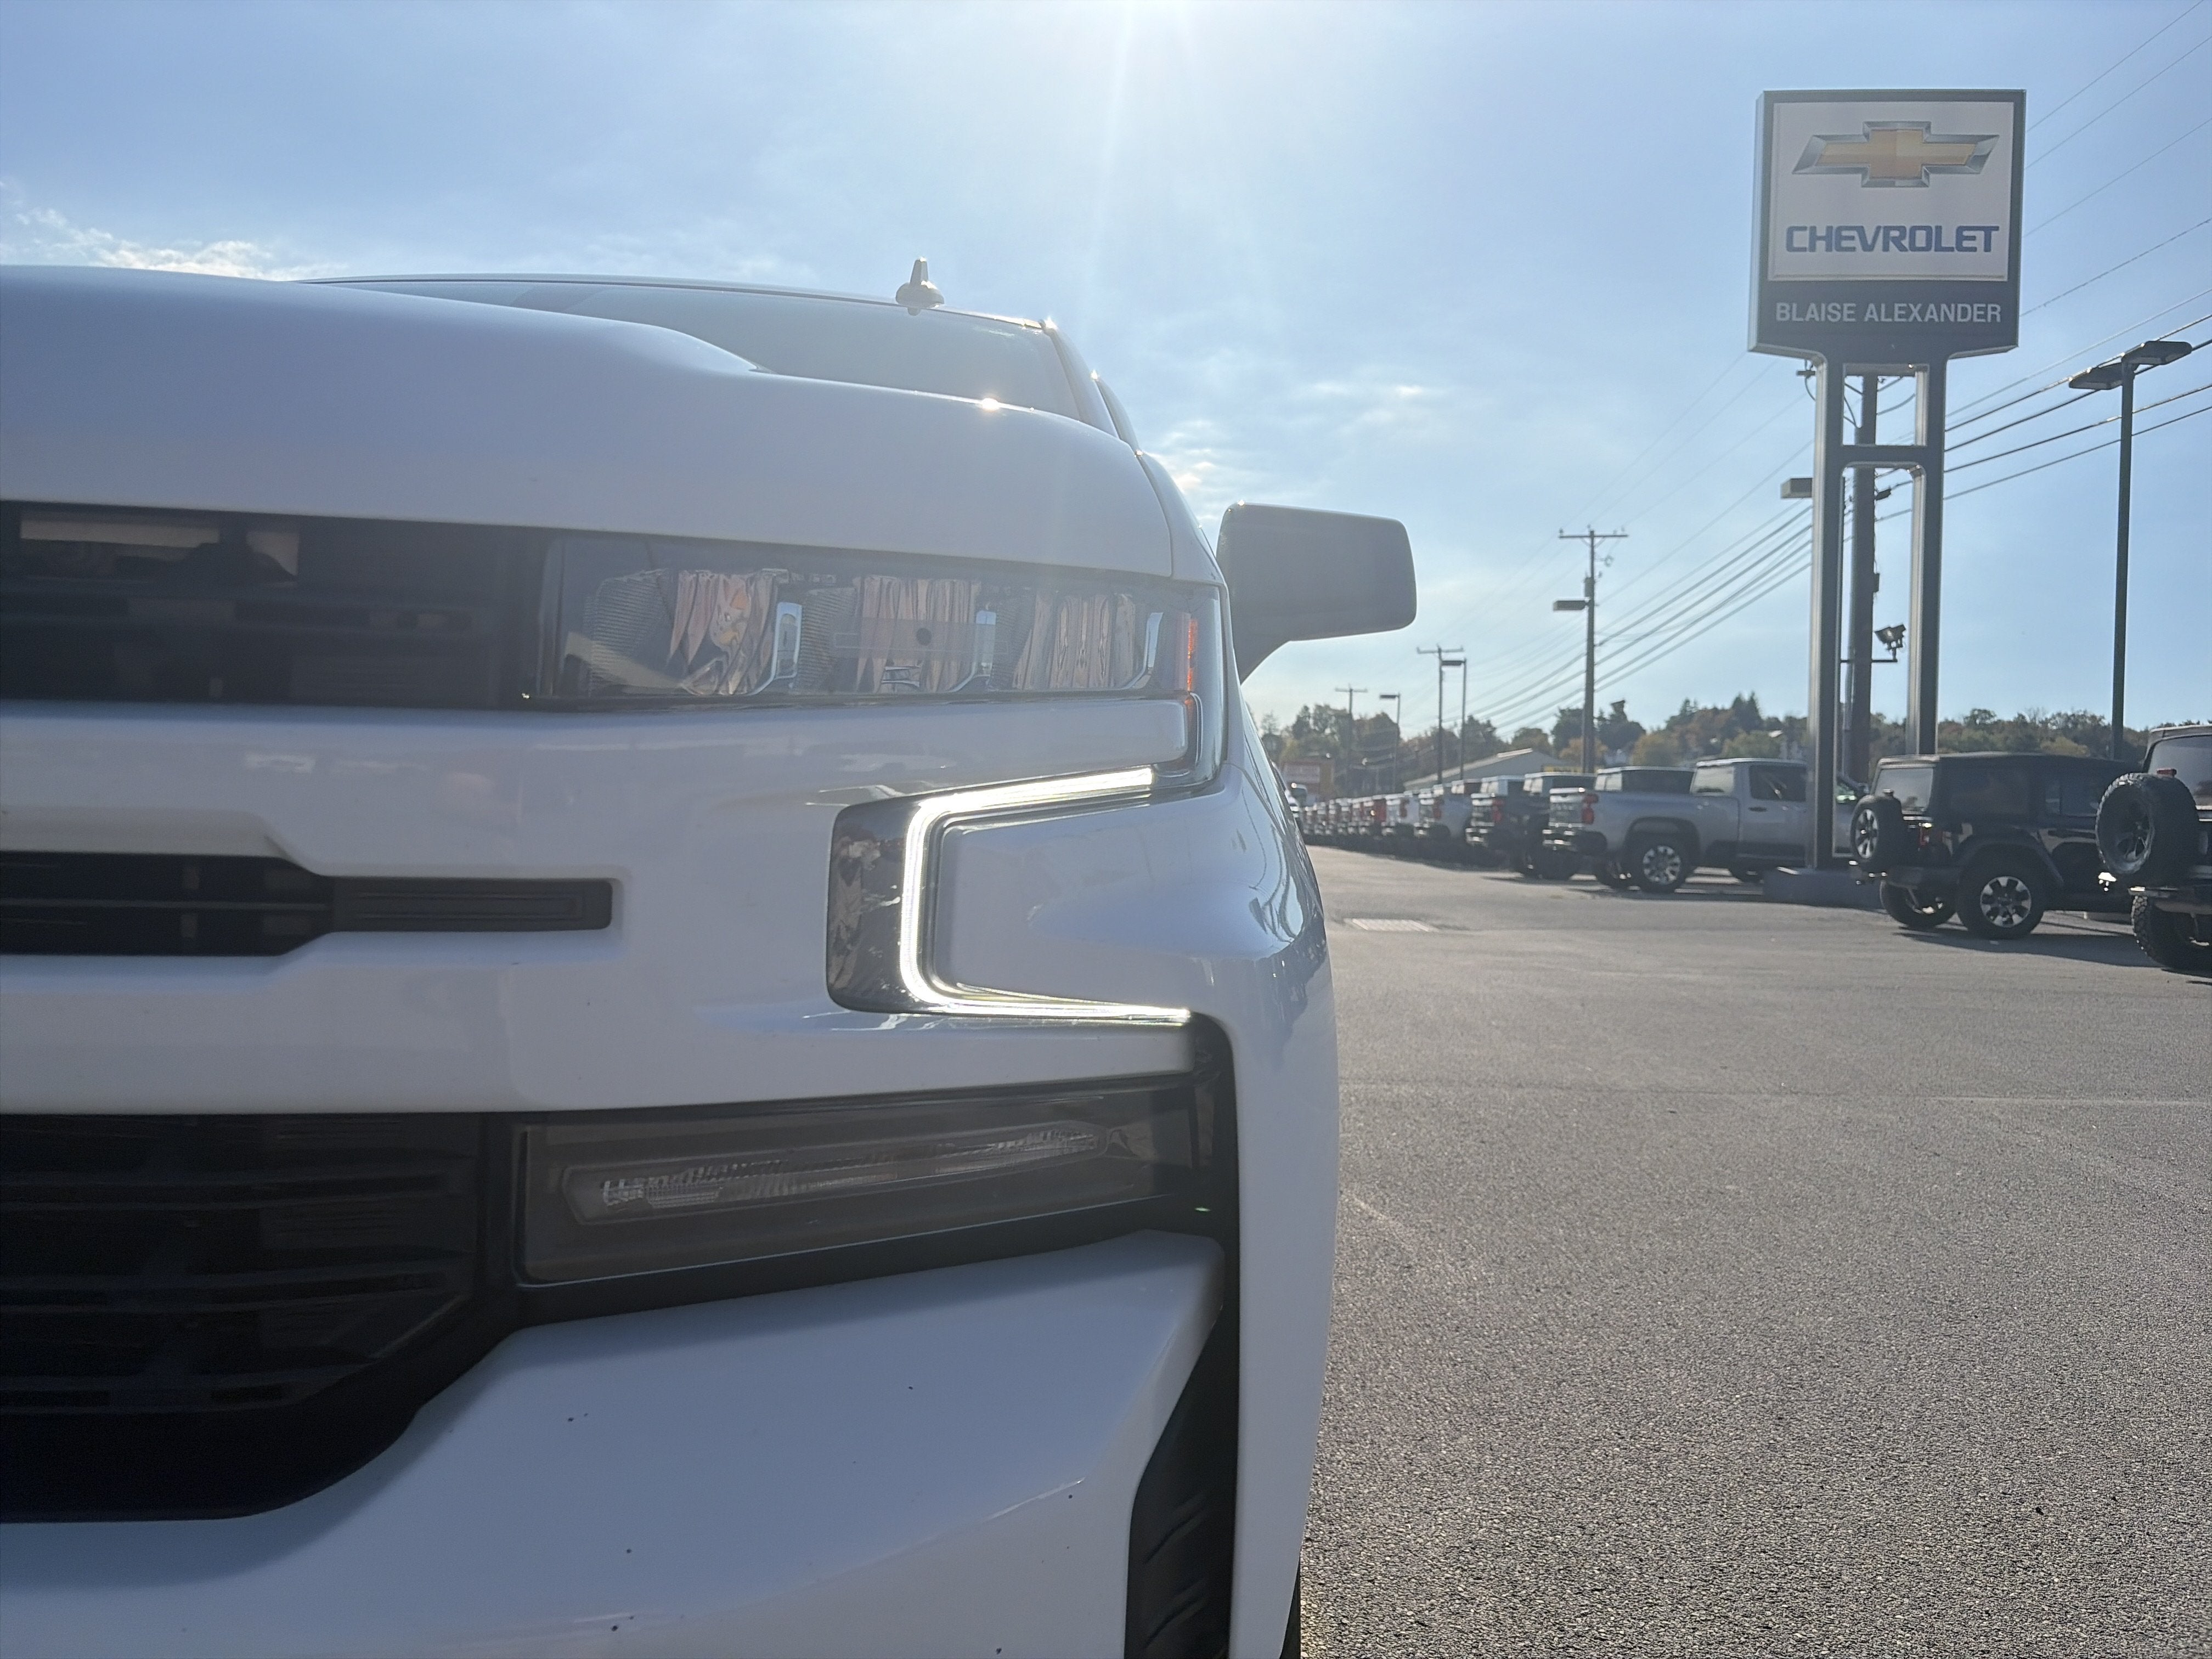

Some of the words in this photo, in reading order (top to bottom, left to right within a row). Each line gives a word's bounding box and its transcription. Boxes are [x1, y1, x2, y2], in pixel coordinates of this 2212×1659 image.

[1786, 225, 2000, 252] CHEVROLET
[1776, 302, 1857, 323] BLAISE
[1865, 303, 2001, 323] ALEXANDER
